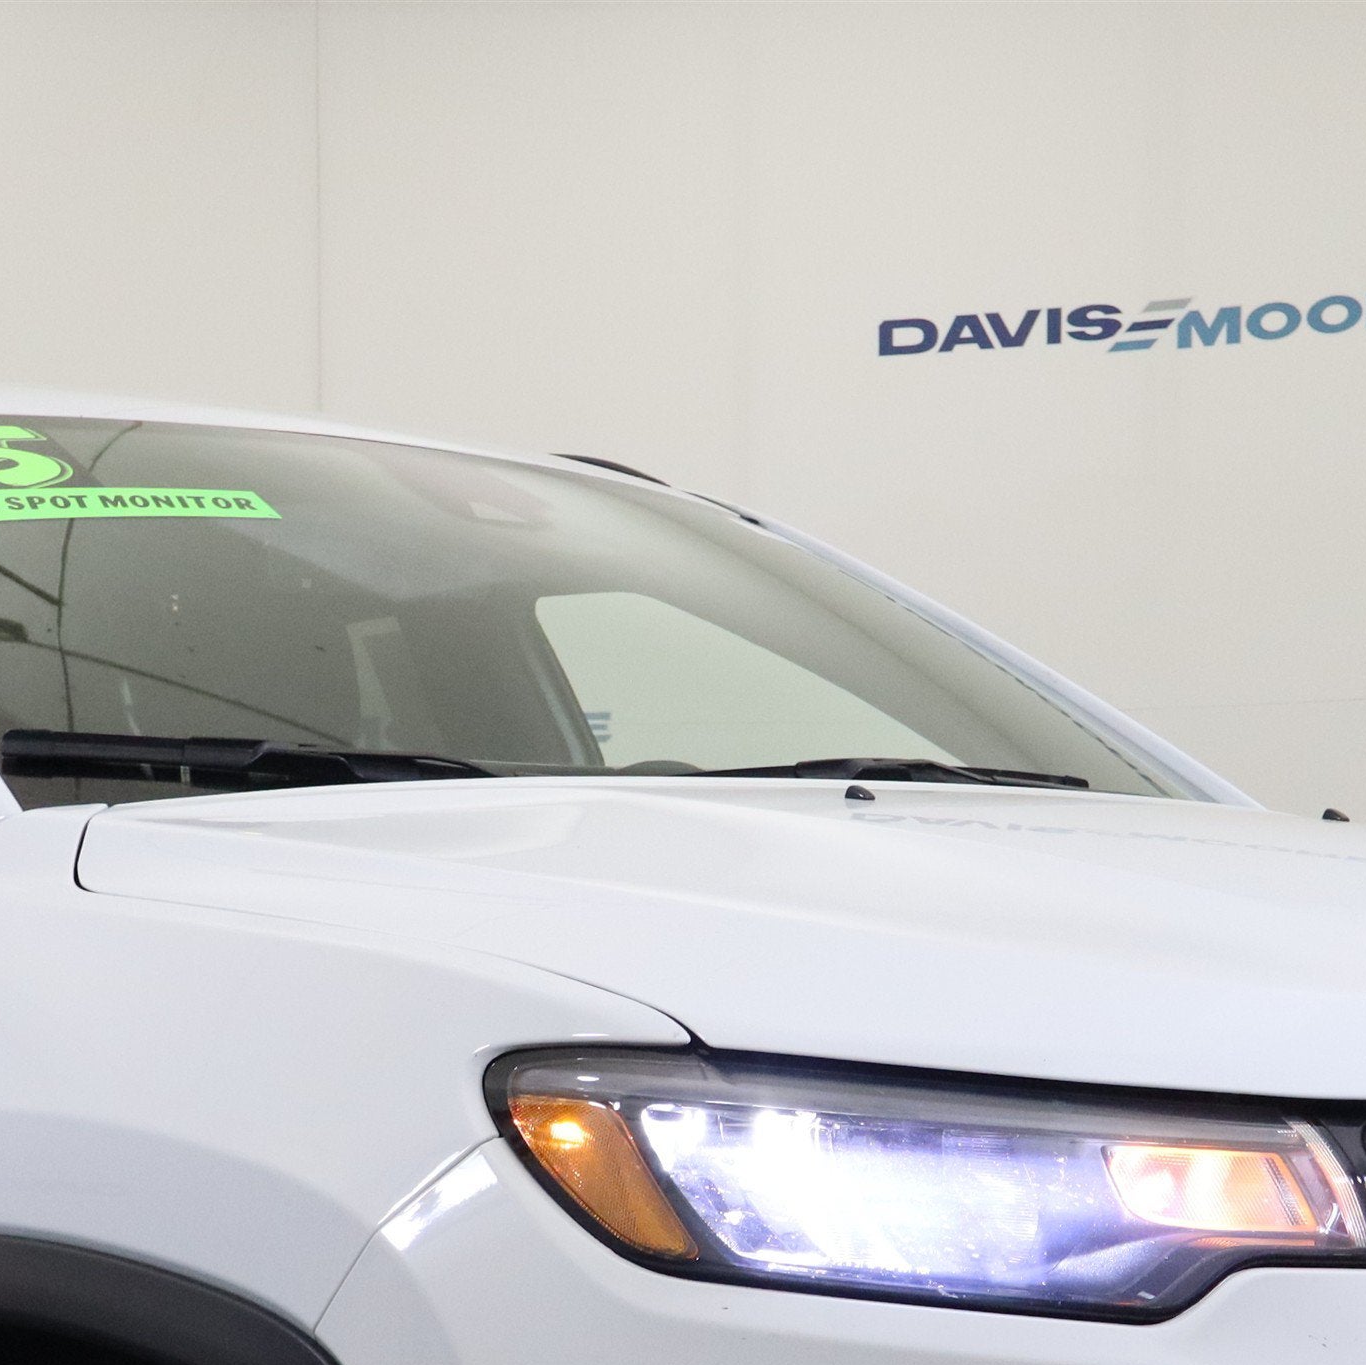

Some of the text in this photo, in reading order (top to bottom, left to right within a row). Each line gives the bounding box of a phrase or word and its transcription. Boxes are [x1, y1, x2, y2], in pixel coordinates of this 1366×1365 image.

[878, 304, 1123, 356] DAVIS
[7, 493, 89, 511] SPOT
[101, 493, 258, 512] MONITOR
